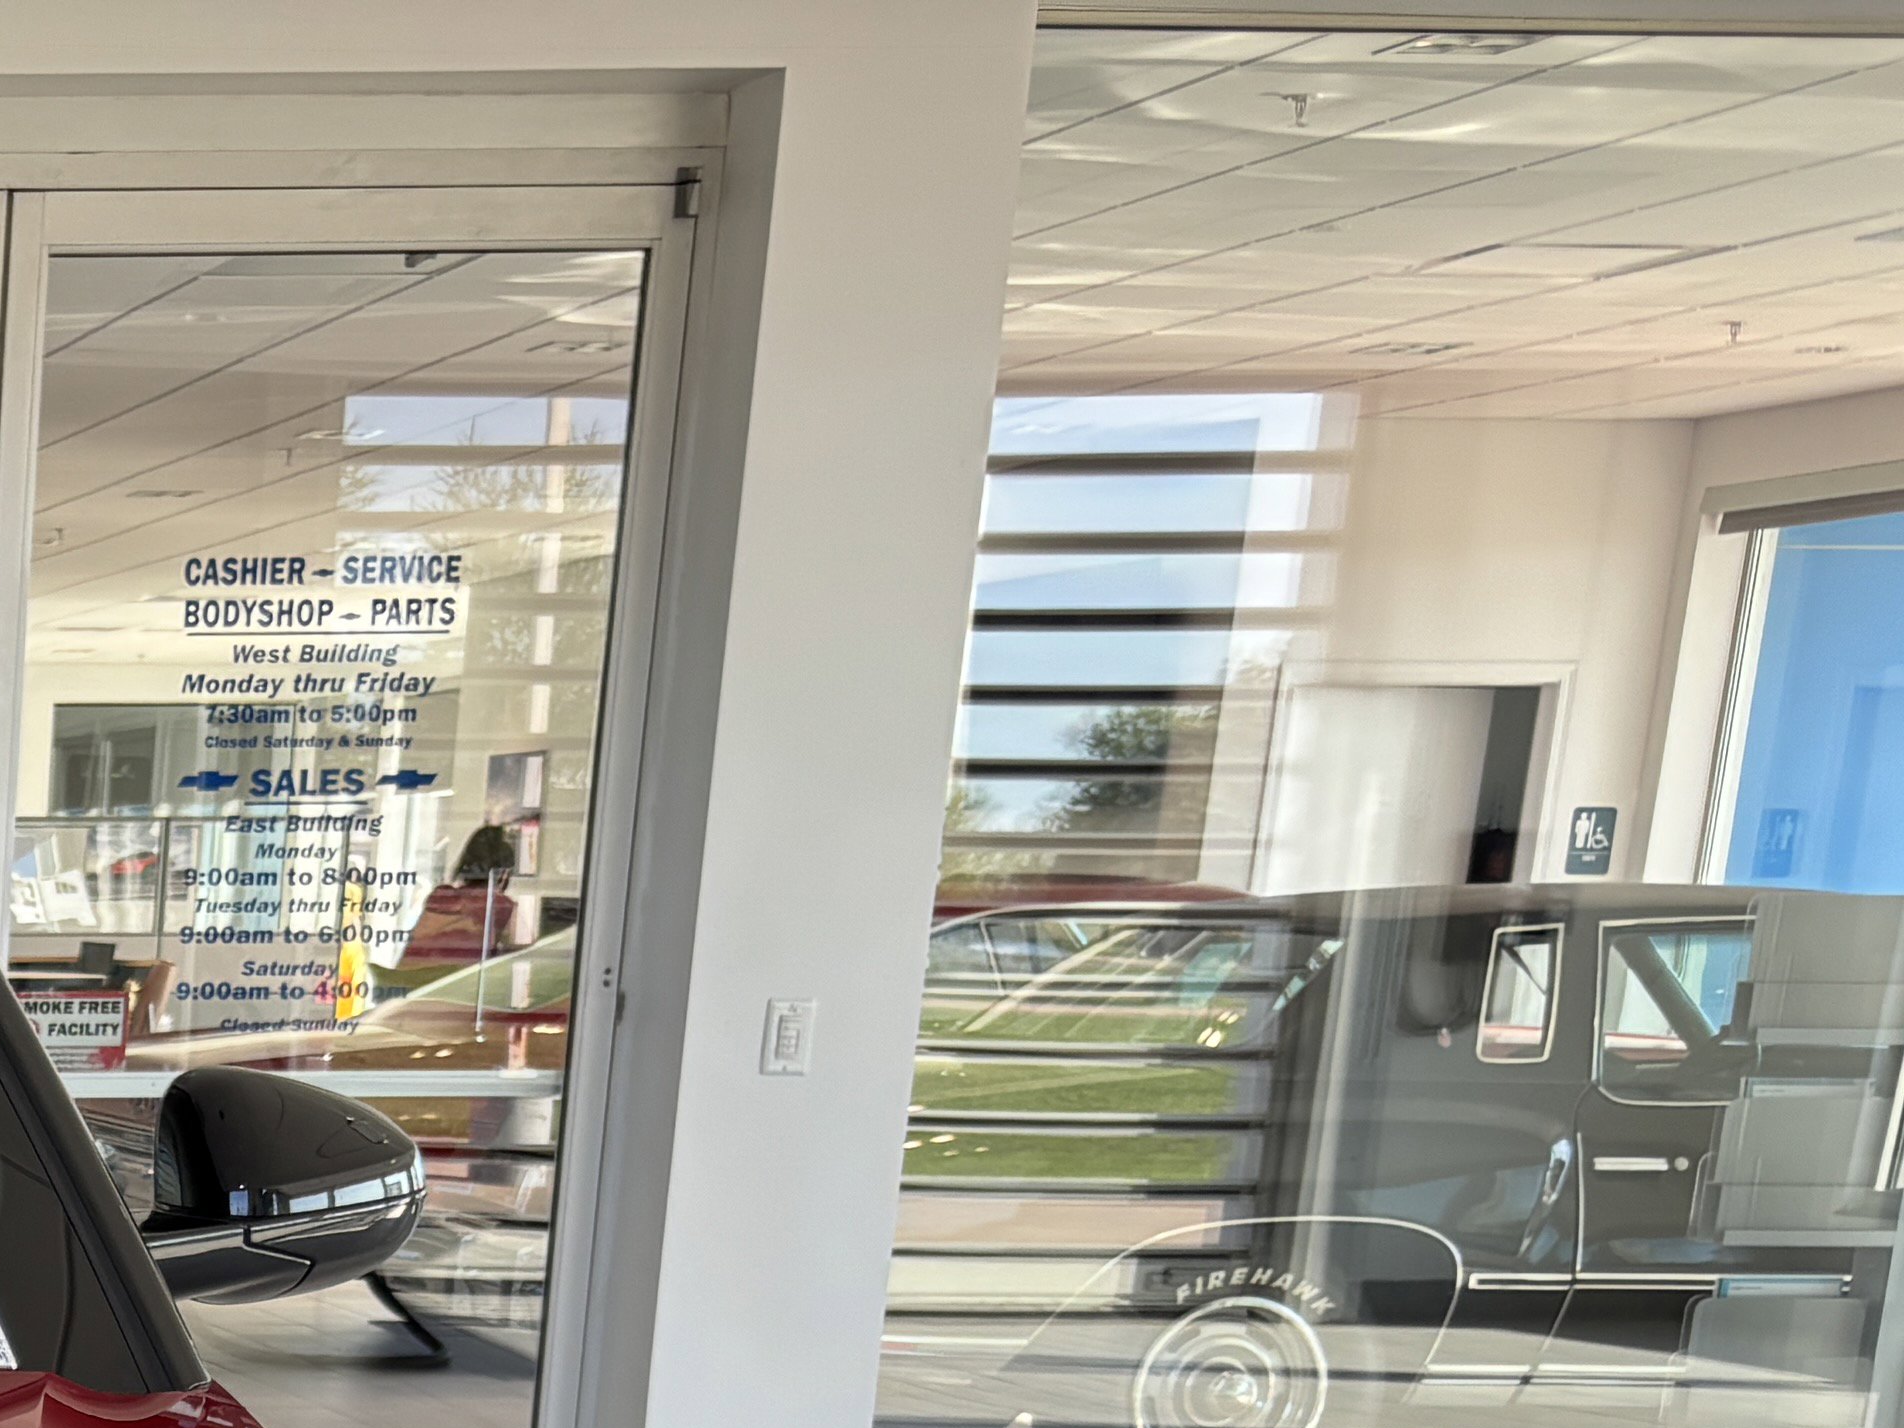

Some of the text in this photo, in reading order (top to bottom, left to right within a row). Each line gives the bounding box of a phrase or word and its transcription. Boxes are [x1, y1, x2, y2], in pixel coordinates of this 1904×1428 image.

[184, 555, 462, 586] CASHIER SERVICE
[184, 597, 456, 628] BODYSHOP PARTS
[233, 643, 400, 667] West Building
[181, 671, 437, 698] Monday thru Friday
[205, 705, 418, 726] 7:30am to 5:00pm
[205, 735, 413, 750] Closed Saturday & Sunday
[249, 768, 365, 797] SALES
[224, 814, 384, 837] East Building
[254, 843, 338, 862] Monday
[184, 868, 417, 890] 9:00am to 8:00pm
[194, 897, 403, 917] Tuesday thru Friday
[180, 925, 414, 947] 9:00am to 6:00pm
[241, 961, 339, 979] Saturday
[176, 982, 270, 1001] 9:00am
[280, 982, 304, 1000] to
[24, 1001, 122, 1015] MOKE FREE
[48, 1022, 120, 1036] FACILITY
[1175, 1266, 1336, 1316] FIREHAWK
